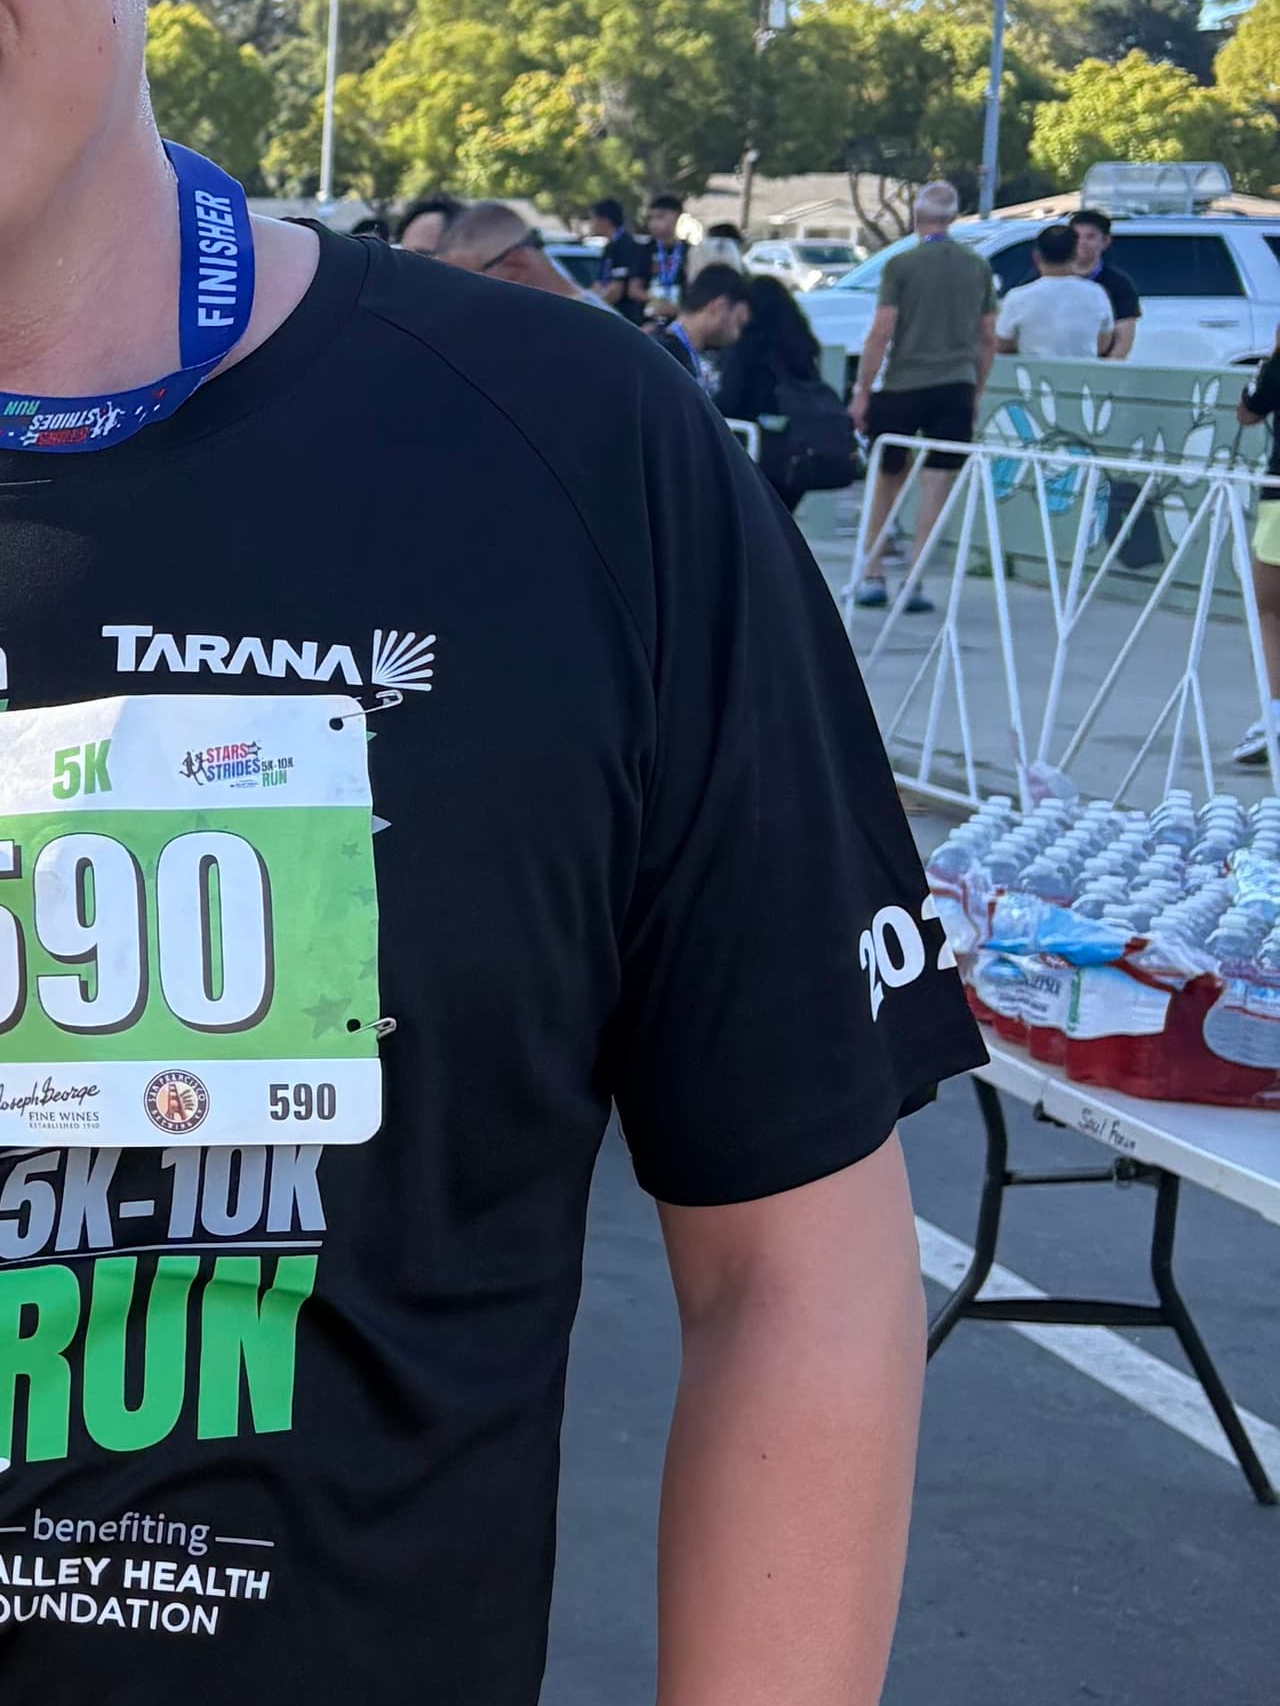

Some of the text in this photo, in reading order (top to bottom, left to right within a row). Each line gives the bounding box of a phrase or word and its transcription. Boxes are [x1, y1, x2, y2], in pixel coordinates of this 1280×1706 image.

[194, 190, 239, 327] FINISHER
[3, 400, 41, 415] RUN
[28, 407, 100, 430] STRIDES
[102, 625, 362, 686] TARANA
[206, 743, 248, 764] STARS
[52, 739, 113, 800] 5K
[206, 757, 260, 782] STRIDES
[262, 770, 288, 787] RUN
[29, 1110, 100, 1122] FINE WINES
[269, 1083, 336, 1121] 590
[33, 1509, 210, 1556] benefiting
[123, 1559, 270, 1600] HEALTH
